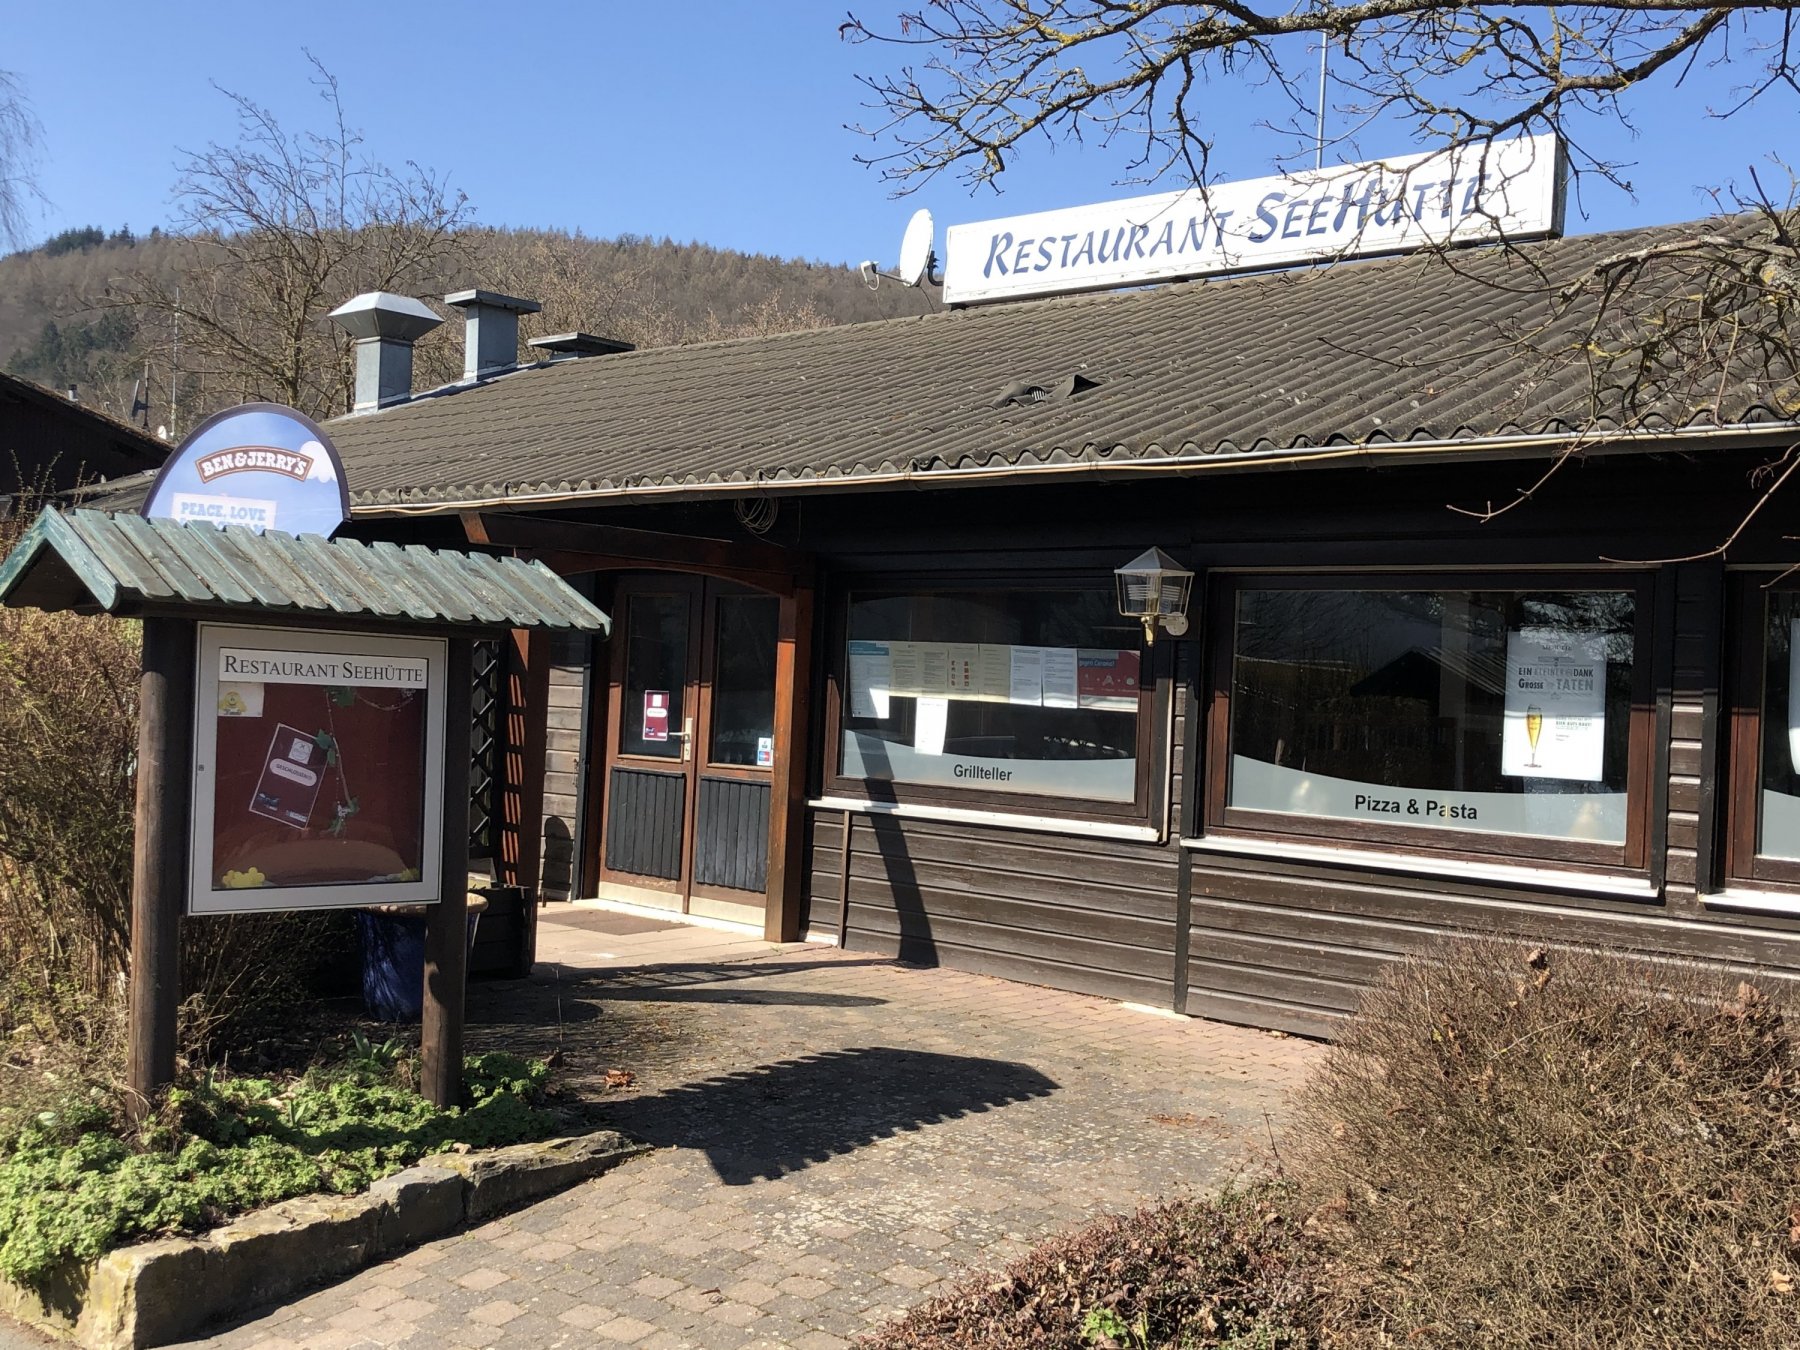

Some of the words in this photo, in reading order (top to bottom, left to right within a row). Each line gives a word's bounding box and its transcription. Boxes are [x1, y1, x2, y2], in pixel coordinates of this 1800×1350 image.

[983, 210, 1234, 278] RESTAURANT
[181, 502, 227, 517] PEACE,
[231, 506, 266, 521] LOVE
[224, 655, 339, 678] RESTAURANT
[342, 661, 423, 682] SEEHÜTTE
[1518, 667, 1532, 676] EIN
[1573, 668, 1594, 677] DANK
[1556, 678, 1594, 691] TATEN
[953, 764, 1013, 781] Grillteller
[1355, 794, 1400, 813] Pizza
[1406, 798, 1419, 815] &
[1426, 800, 1477, 820] Pasta
